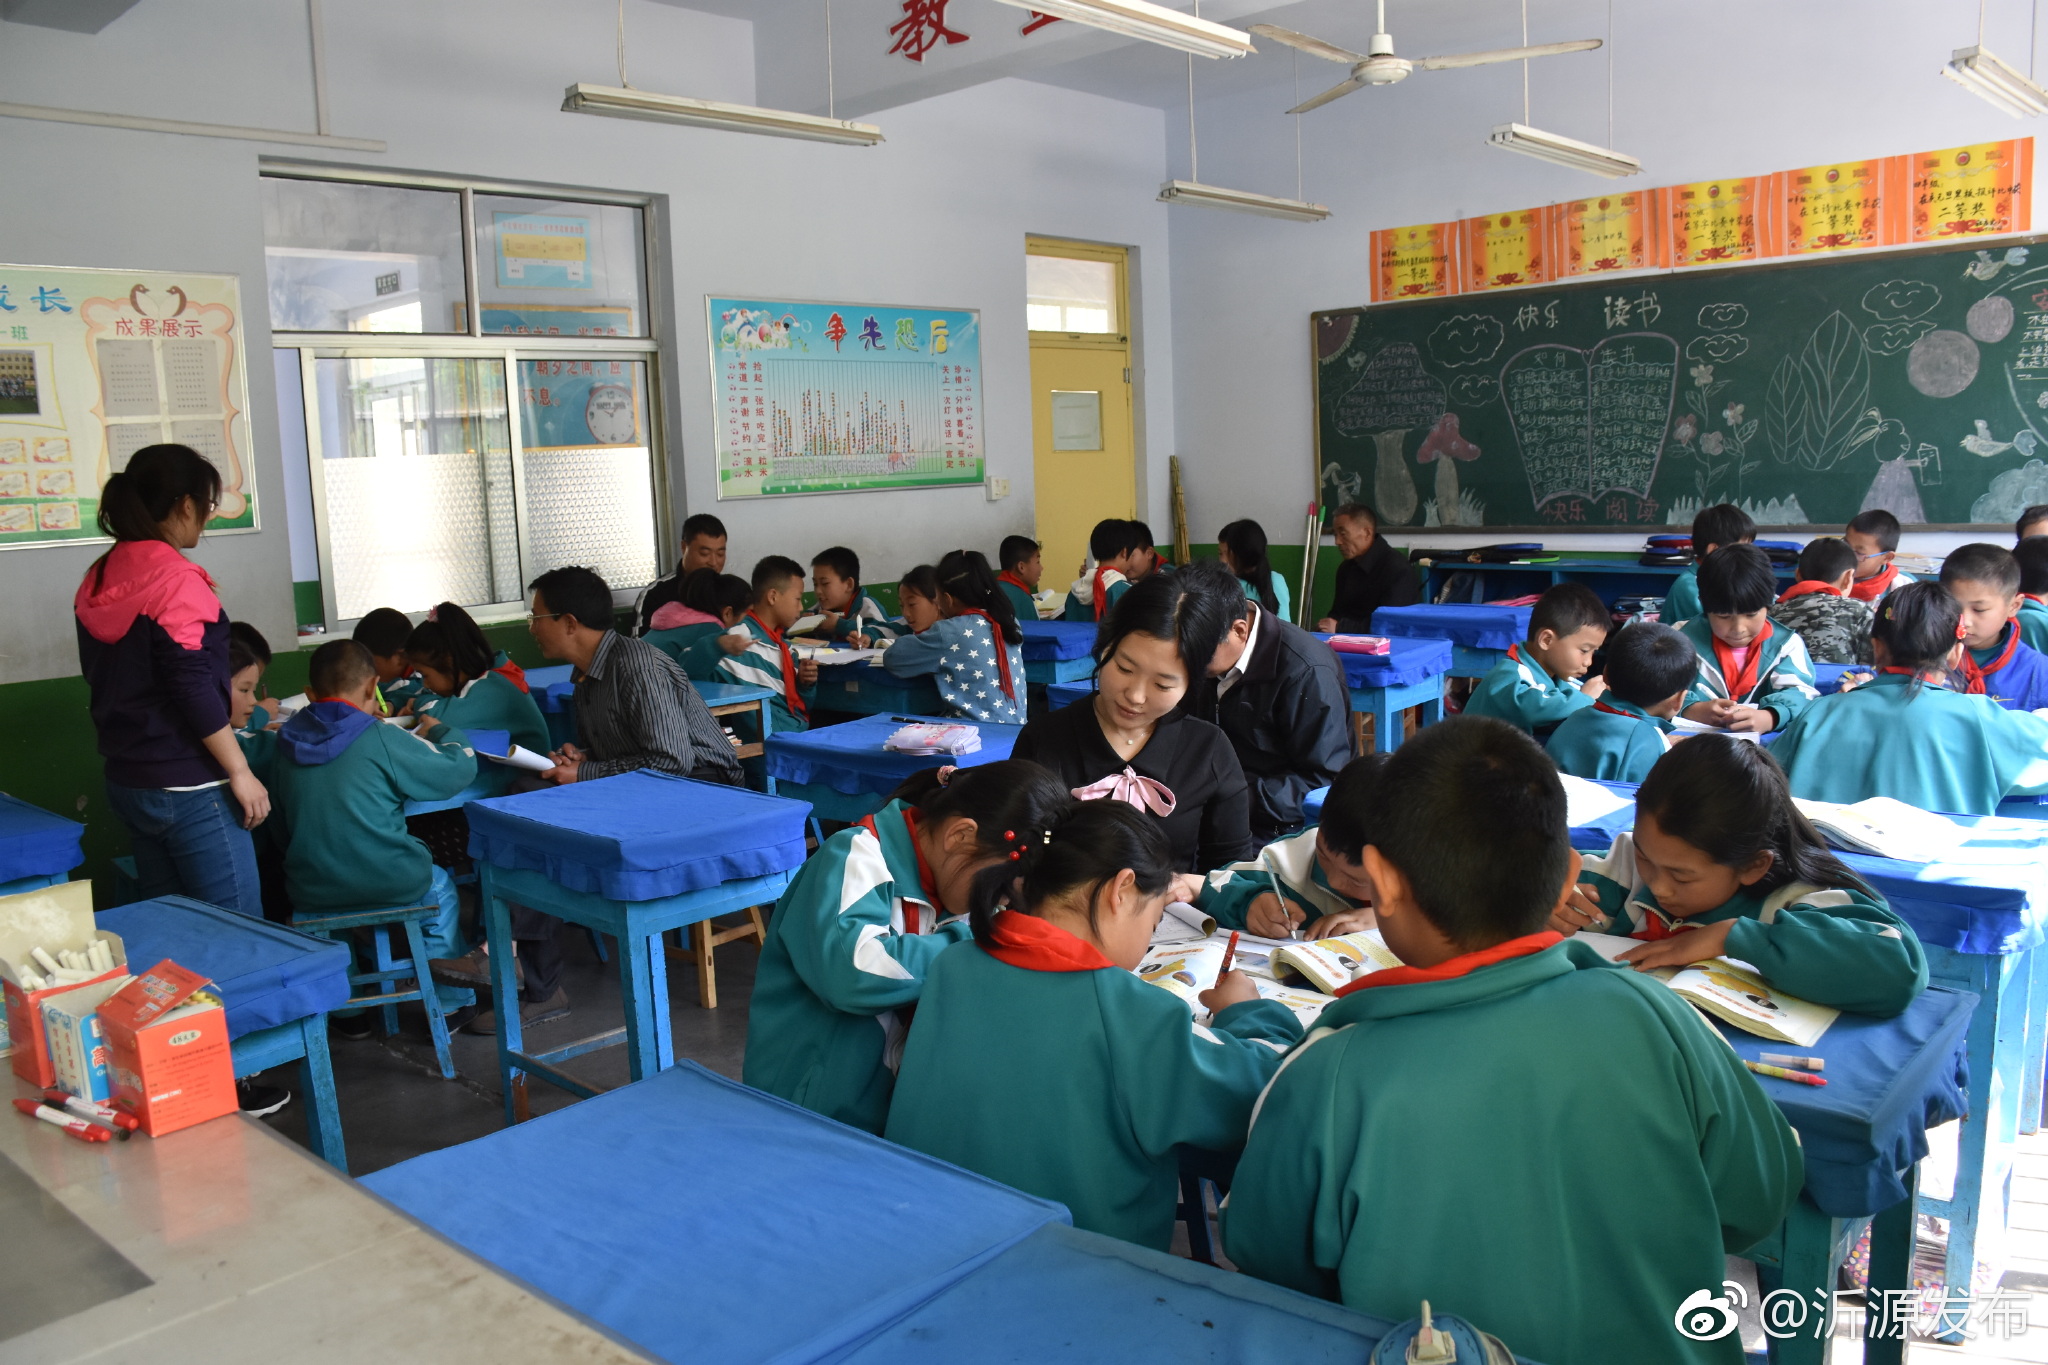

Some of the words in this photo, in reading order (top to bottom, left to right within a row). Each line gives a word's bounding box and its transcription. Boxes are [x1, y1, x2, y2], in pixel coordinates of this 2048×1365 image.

[1811, 213, 1855, 229] 一等奖
[1938, 202, 1987, 219] 二等奖
[1693, 230, 1736, 245] 一等奖
[1513, 299, 1560, 332] 快乐
[1603, 290, 1661, 330] 读书
[115, 317, 204, 338] 成果展示
[824, 312, 949, 355] 争先恐后
[1543, 499, 1586, 523] 快乐
[1606, 497, 1660, 523] 阅读
